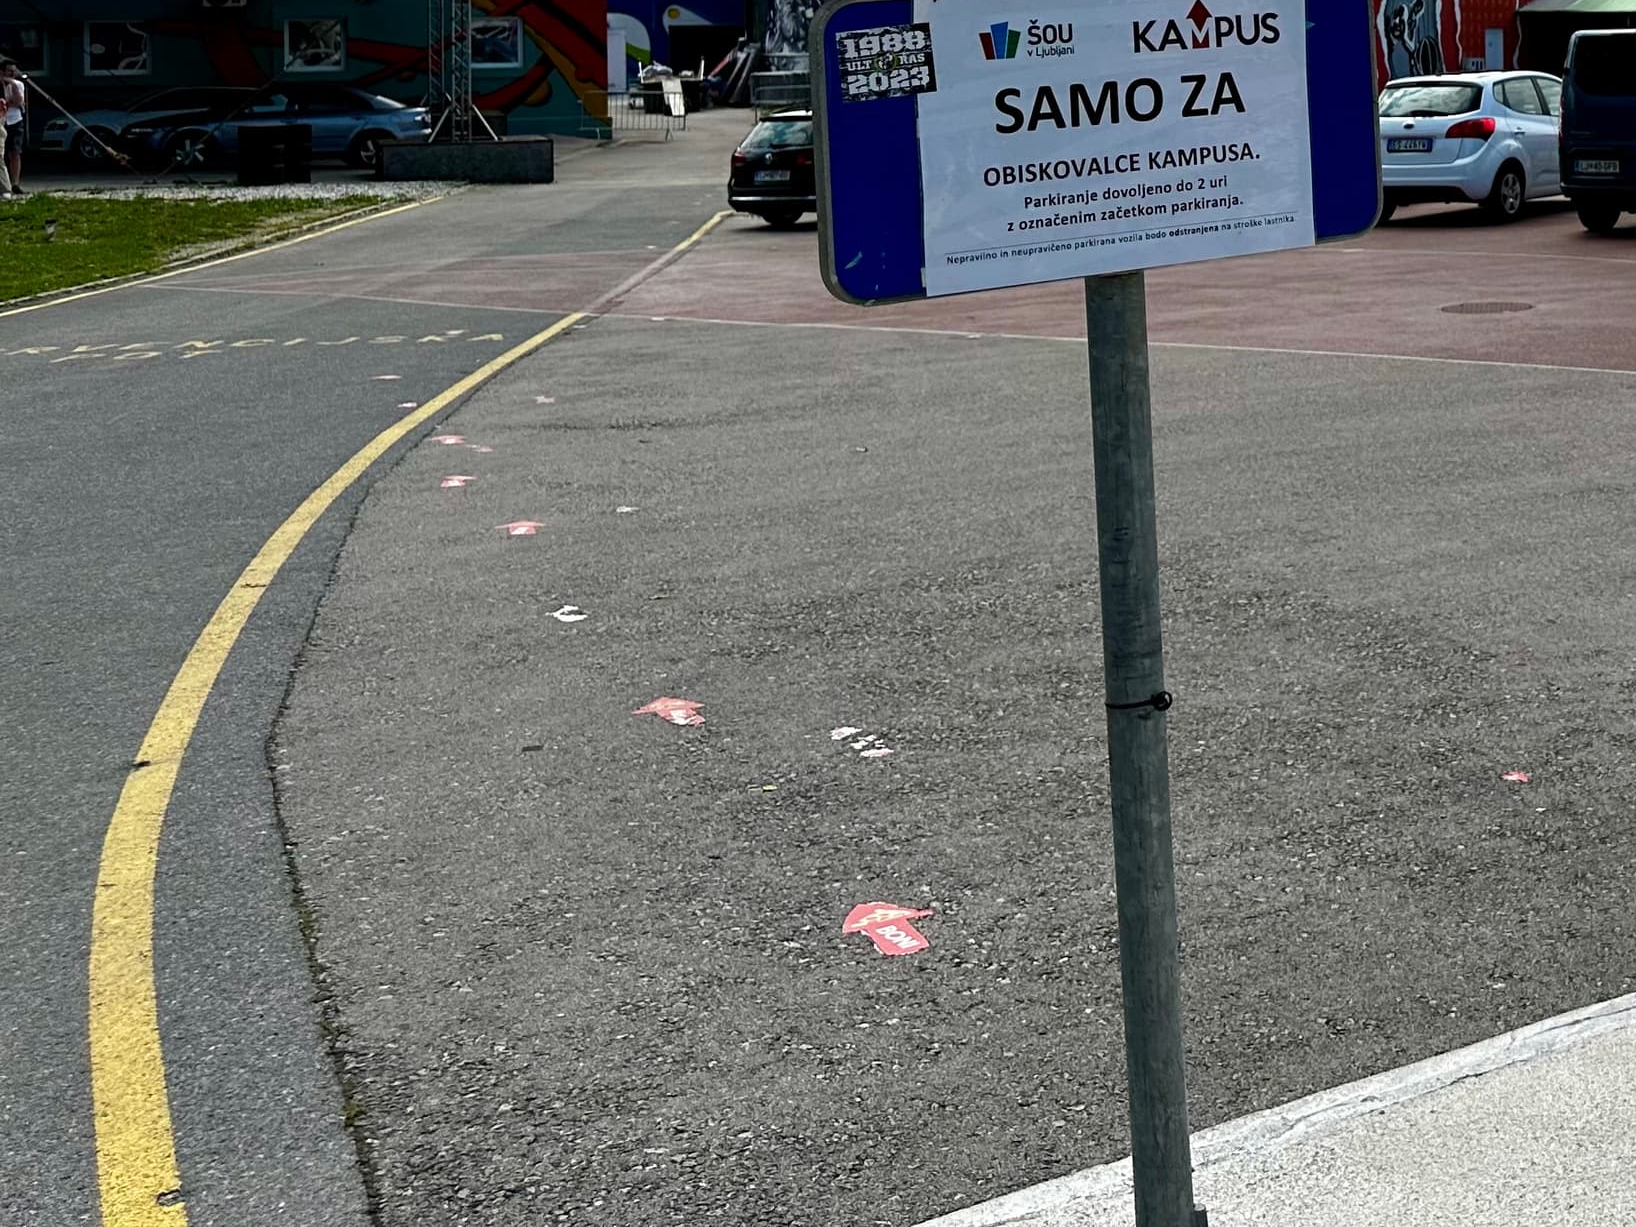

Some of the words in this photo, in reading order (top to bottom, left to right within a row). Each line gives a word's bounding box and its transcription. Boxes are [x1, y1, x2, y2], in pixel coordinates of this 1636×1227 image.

[842, 30, 926, 59] 1988
[1027, 19, 1074, 46] ŠOU
[1035, 46, 1075, 60] Ljubljani
[847, 66, 930, 94] 2023
[994, 77, 1164, 134] SAMO
[1180, 72, 1246, 118] ZA
[983, 153, 1141, 187] OBISKOVALCE
[1148, 142, 1261, 170] KAMPUSA.
[1024, 190, 1098, 209] Parkiranje
[1103, 183, 1172, 200] dovoljeno
[1176, 179, 1193, 192] do
[1198, 178, 1206, 190] 2
[1209, 175, 1228, 189] uri
[1007, 221, 1014, 231] z
[1019, 212, 1097, 231] označenim
[1100, 204, 1167, 221] začetkom
[1171, 195, 1244, 215] parkiranja.
[946, 252, 998, 266] Nepravilno
[1000, 250, 1008, 258] in
[1011, 242, 1072, 257] neupravičeno
[1074, 238, 1116, 251] parkirana
[1118, 232, 1143, 243] vozila
[1145, 229, 1167, 240] bodo
[1169, 223, 1219, 237] odstranjena
[0, 333, 505, 356] RVENCIJSKA
